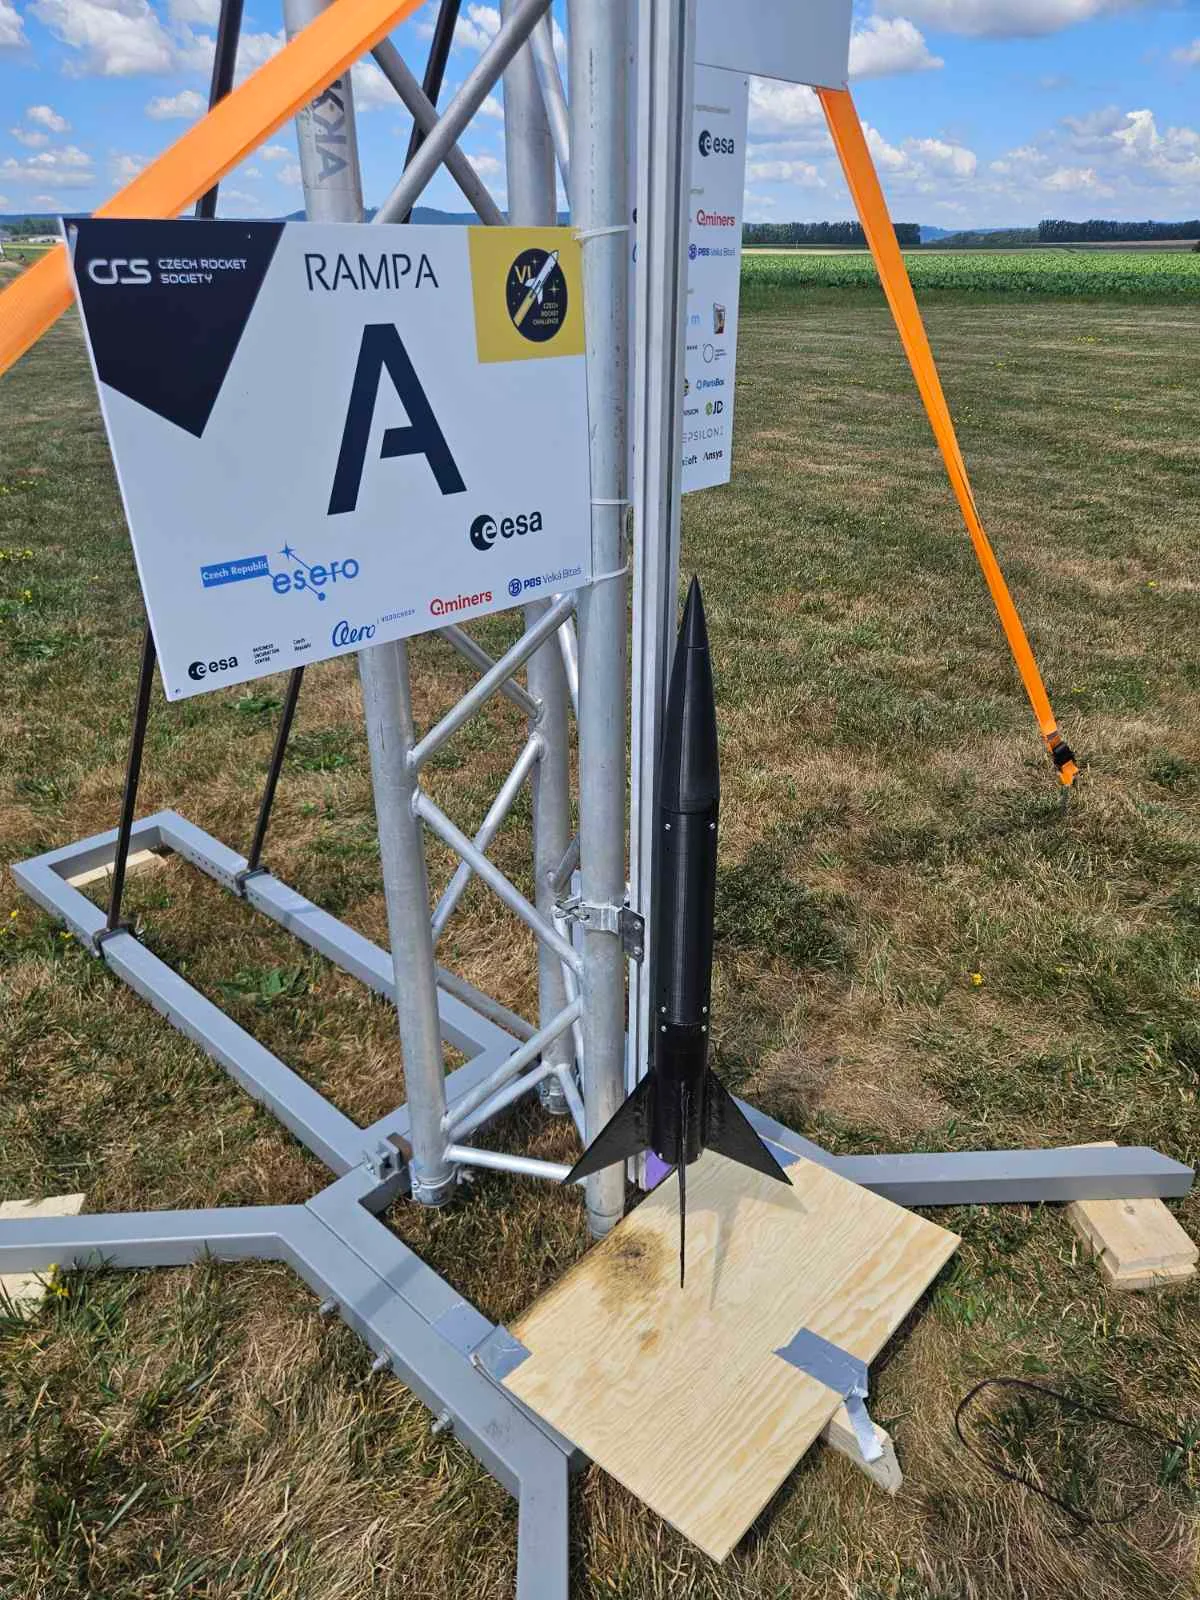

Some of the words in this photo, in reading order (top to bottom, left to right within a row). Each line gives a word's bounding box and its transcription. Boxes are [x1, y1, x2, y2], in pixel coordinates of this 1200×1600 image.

[713, 136, 735, 154] esa
[696, 209, 736, 226] Qminers
[157, 258, 199, 271] CZECH
[200, 259, 247, 271] ROCKET
[304, 253, 440, 291] RAMPA
[160, 274, 213, 284] SOCIETY
[713, 400, 724, 415] JD
[327, 323, 467, 516] A
[500, 511, 543, 539] esa
[201, 569, 229, 582] Czech
[230, 559, 268, 577] Republic
[272, 558, 359, 594] esero
[523, 576, 542, 590] PBS
[430, 590, 493, 616] Qminers
[332, 620, 376, 648] Aero
[208, 655, 238, 673] esa
